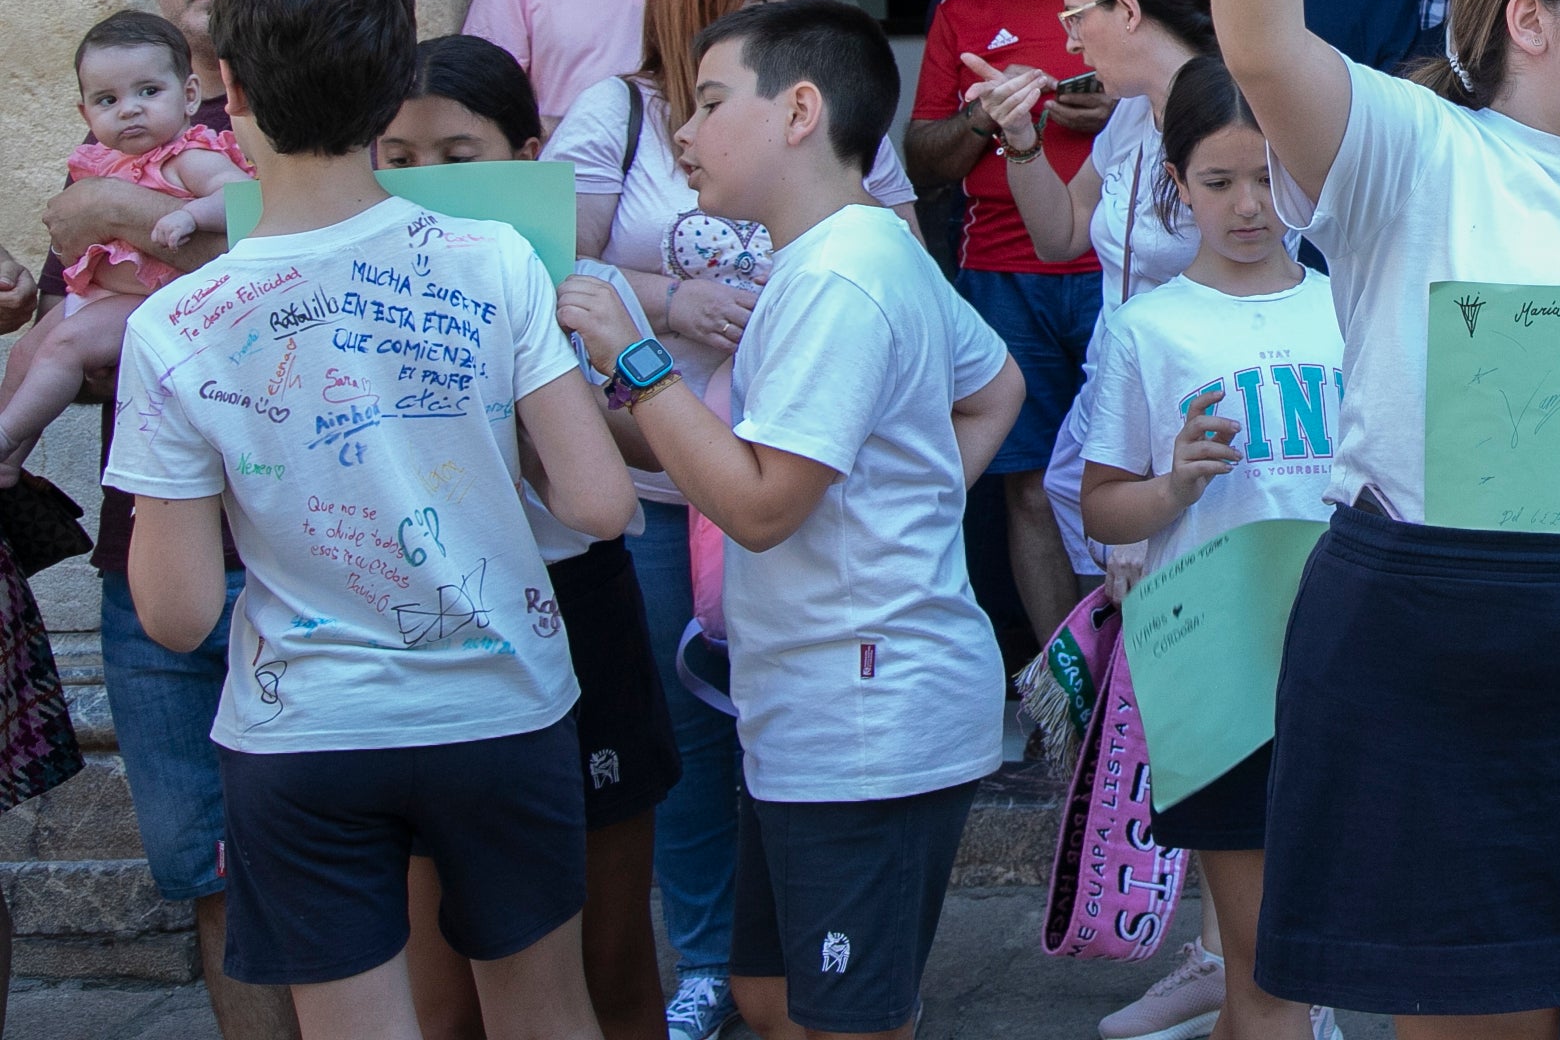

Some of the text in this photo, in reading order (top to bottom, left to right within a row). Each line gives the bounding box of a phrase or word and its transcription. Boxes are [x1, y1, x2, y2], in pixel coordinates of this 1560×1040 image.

[235, 265, 303, 306] Felicidad
[351, 259, 498, 325] MUCHA SUERTE
[341, 291, 482, 349] EN ESTA ETAPA
[332, 327, 374, 355] QUE
[1258, 349, 1292, 360] STAY
[1244, 468, 1262, 480] TO
[307, 494, 378, 521] Que no se
[302, 518, 317, 537] te
[1049, 636, 1091, 730] CÓRDOB
